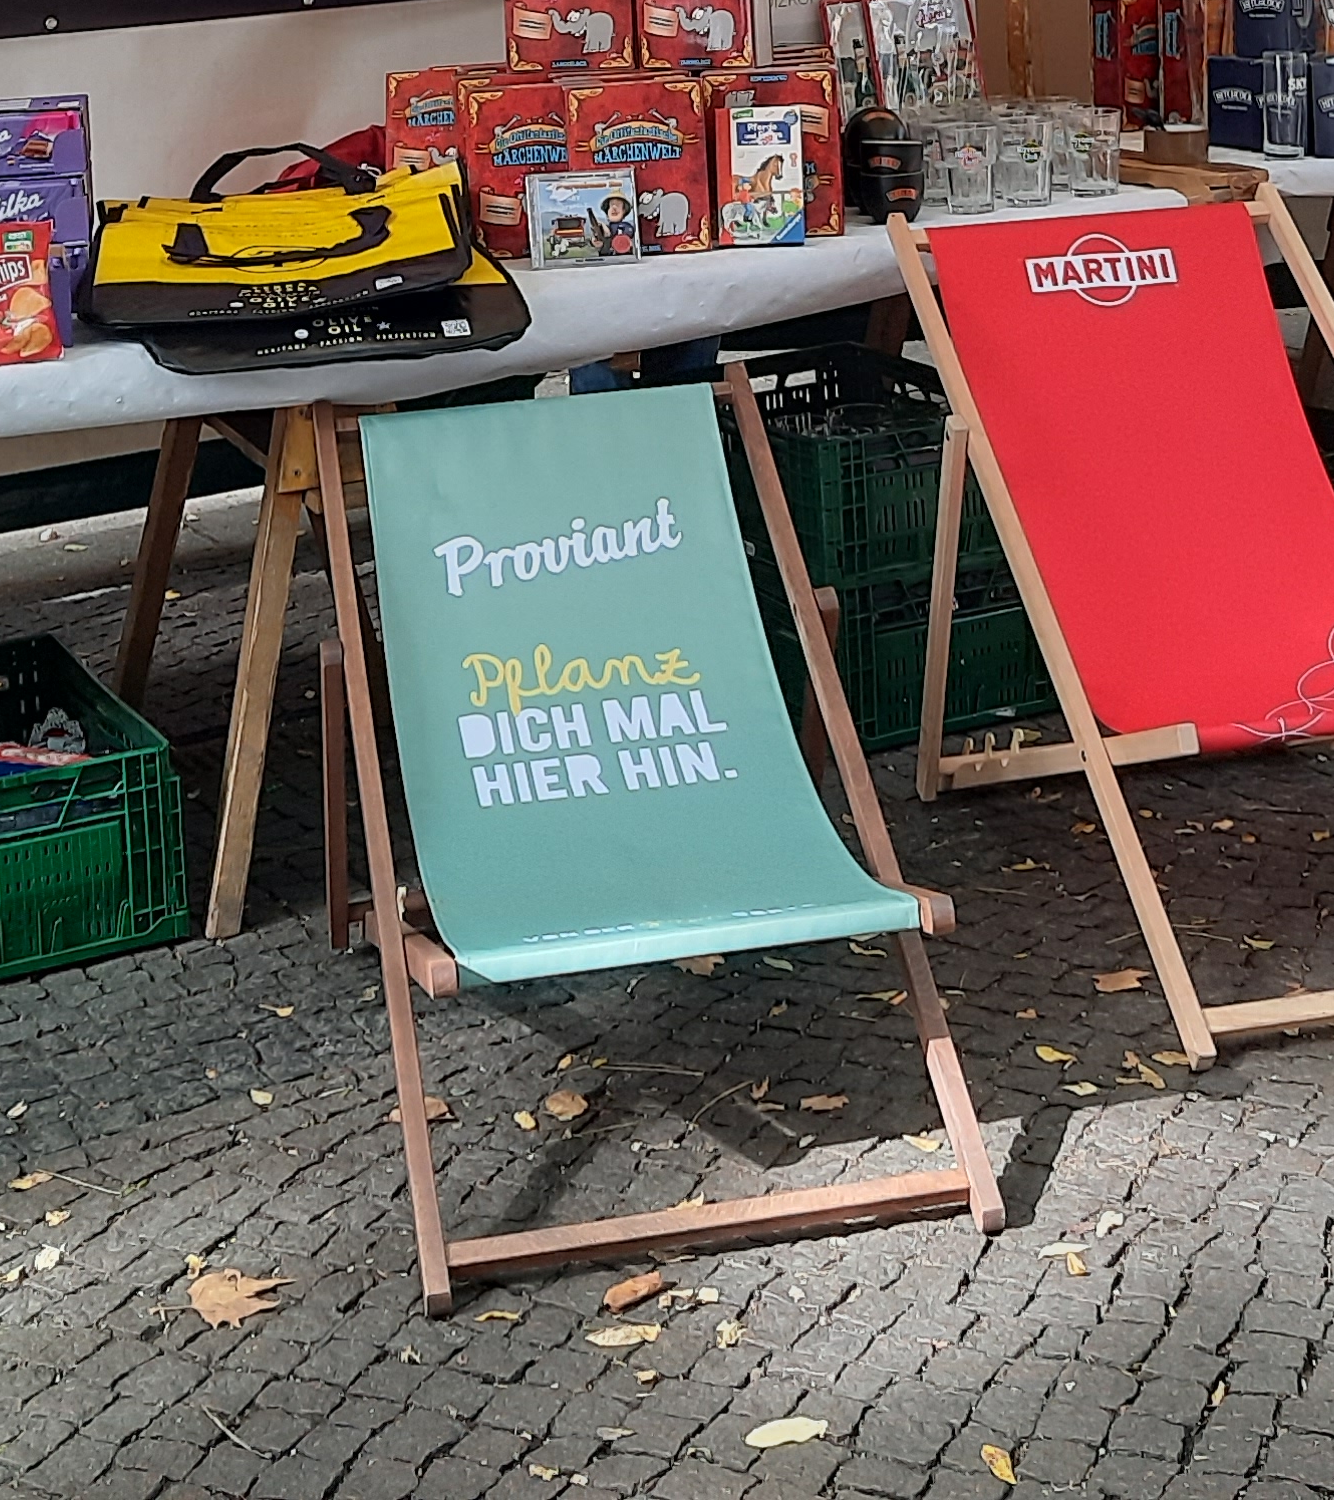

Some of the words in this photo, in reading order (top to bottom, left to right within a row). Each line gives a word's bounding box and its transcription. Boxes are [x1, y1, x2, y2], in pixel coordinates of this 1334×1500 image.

[1032, 253, 1171, 288] MARTINI
[328, 324, 362, 335] OIL
[433, 496, 683, 597] Proviant
[457, 702, 593, 759] DICH
[601, 688, 728, 744] MAL
[471, 753, 610, 808] HIER
[617, 740, 739, 792] HIN.
